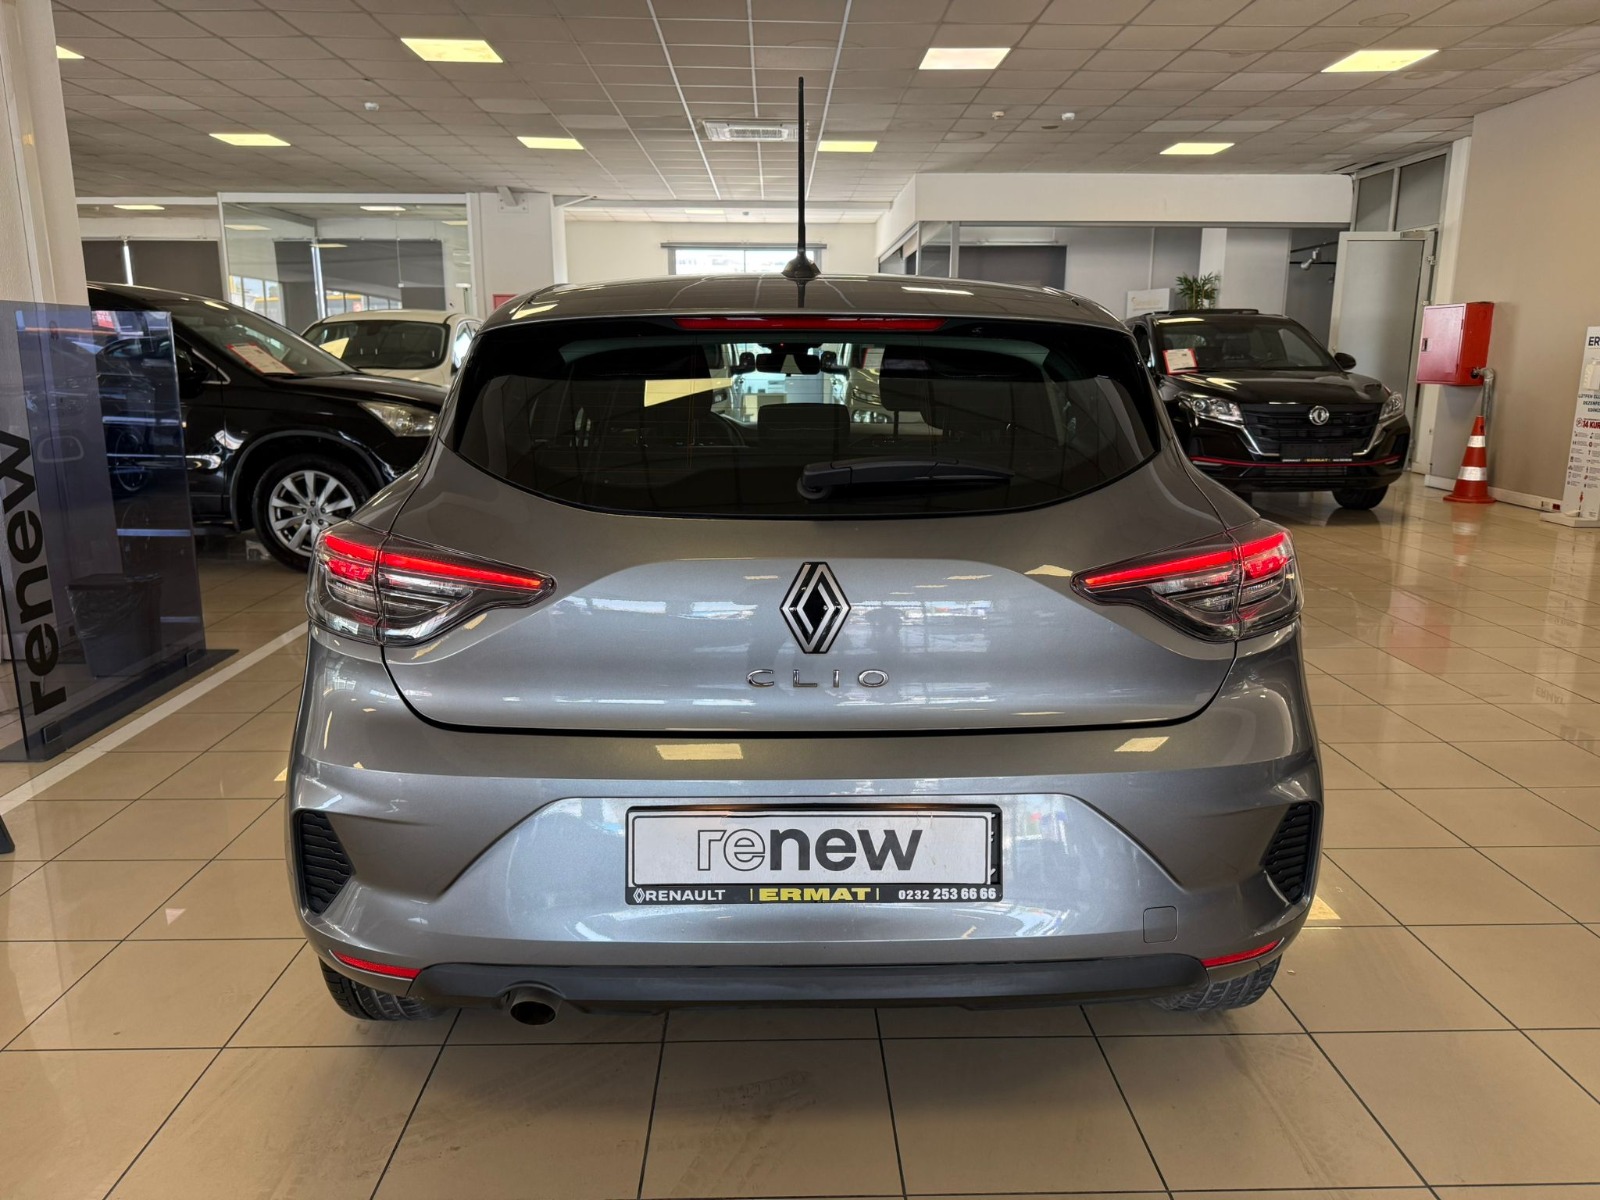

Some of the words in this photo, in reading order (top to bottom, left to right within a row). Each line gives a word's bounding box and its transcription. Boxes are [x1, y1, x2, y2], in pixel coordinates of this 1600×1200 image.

[0, 430, 67, 716] renew
[746, 669, 889, 688] CLIO
[697, 828, 923, 872] renew
[645, 889, 726, 901] RENAULT
[758, 887, 871, 901] ERMAT
[898, 889, 930, 900] 0232
[932, 887, 958, 900] 253
[960, 887, 977, 900] 66
[979, 887, 997, 900] 66
